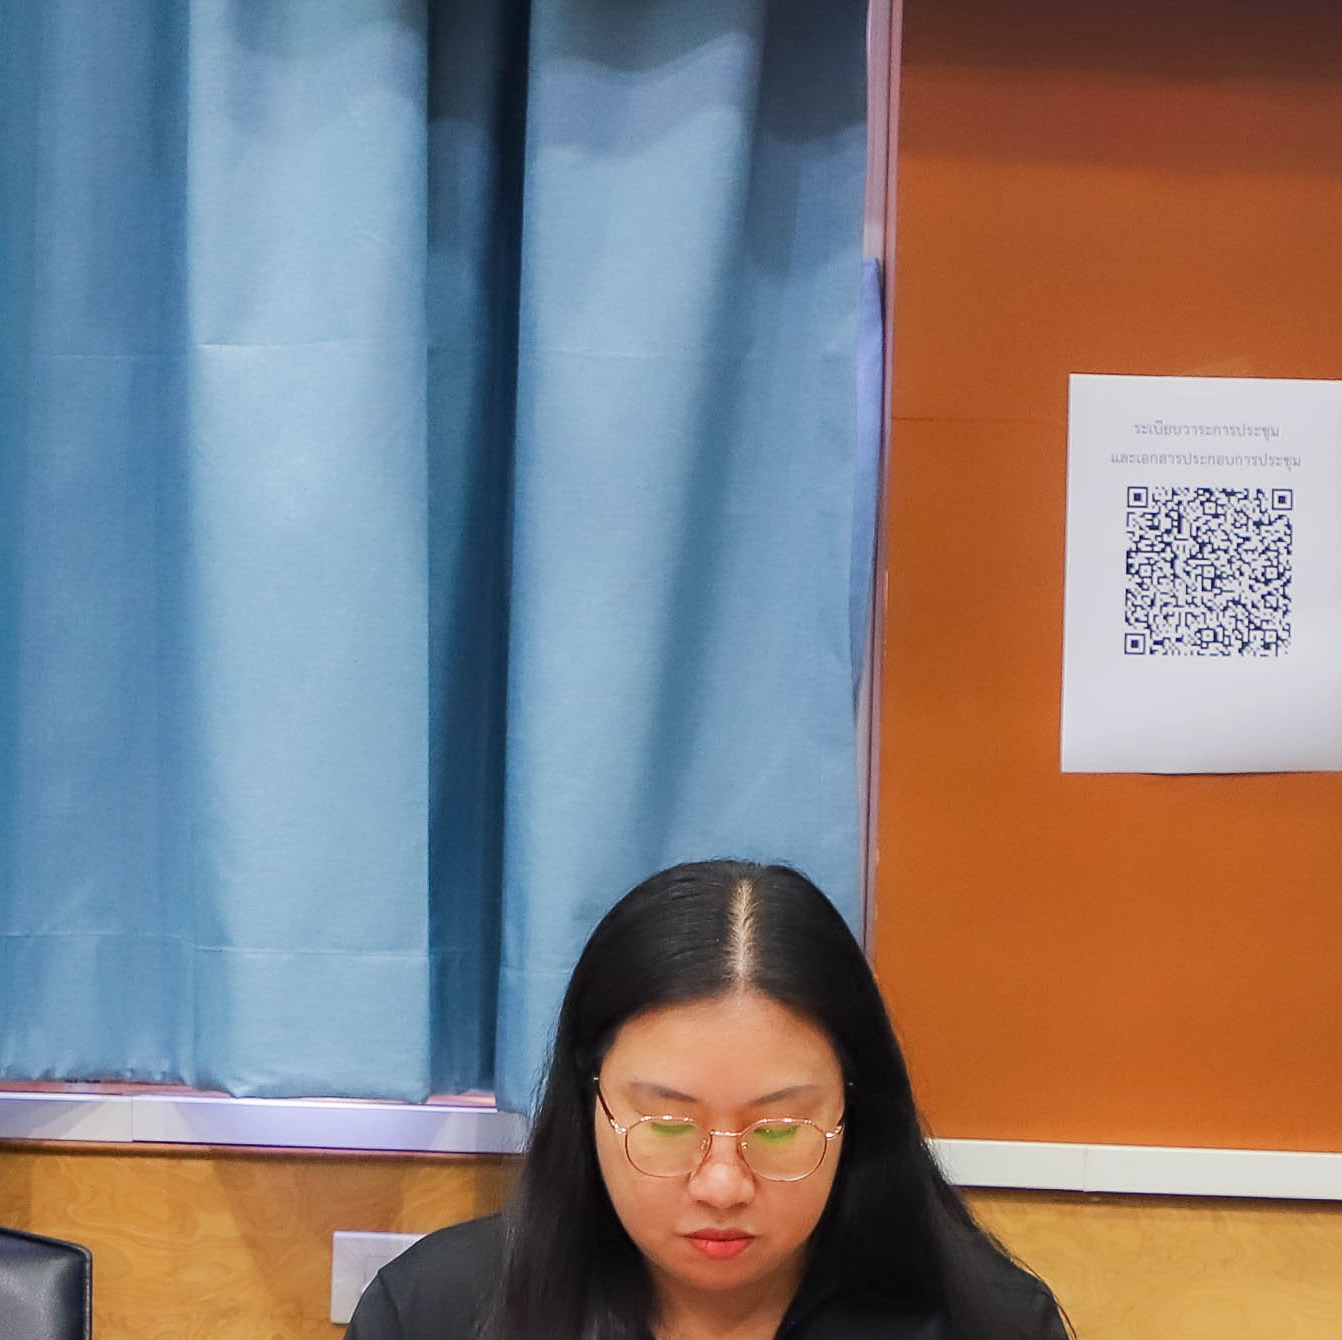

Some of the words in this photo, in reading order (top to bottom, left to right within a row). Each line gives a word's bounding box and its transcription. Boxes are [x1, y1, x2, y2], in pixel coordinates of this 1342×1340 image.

[1134, 420, 1280, 441] ระเบียบวาระการประชุม
[1110, 450, 1302, 471] และเอกสารประกอบการประชุม
